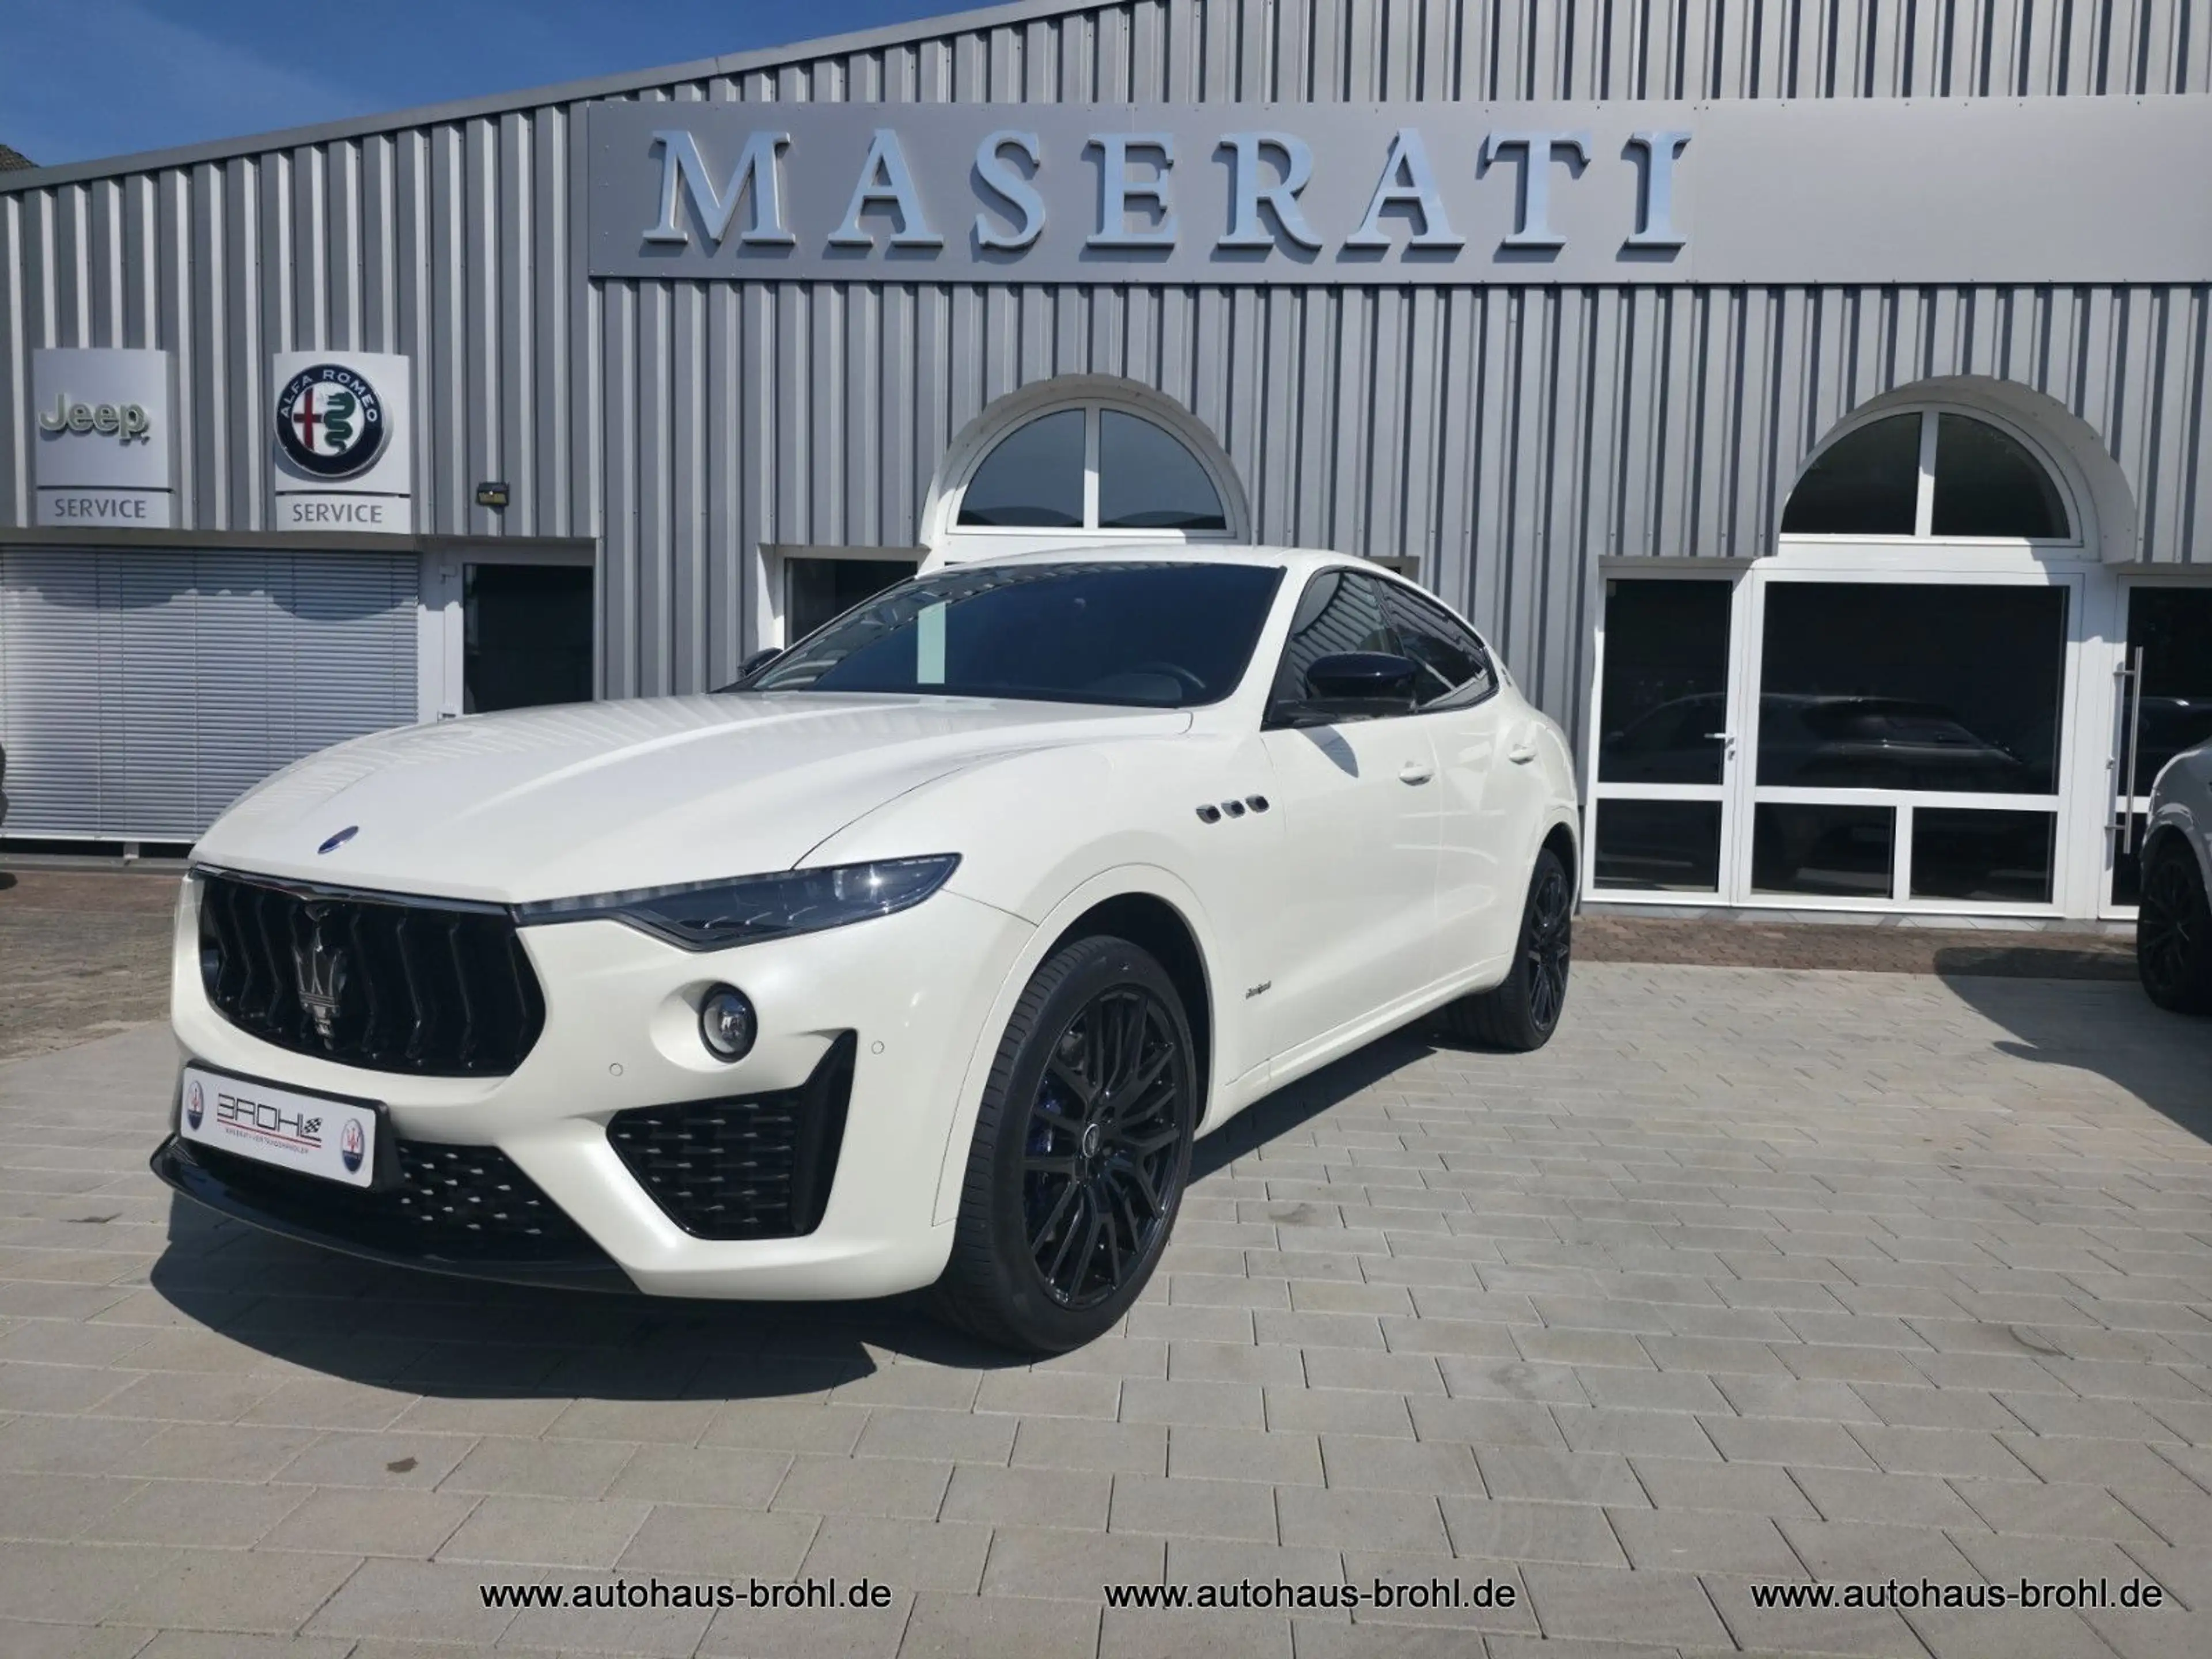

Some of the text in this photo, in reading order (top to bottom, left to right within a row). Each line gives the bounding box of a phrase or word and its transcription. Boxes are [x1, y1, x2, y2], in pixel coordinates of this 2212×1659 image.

[643, 127, 1692, 250] MASERATI
[39, 393, 147, 440] Jeep
[281, 369, 378, 422] ALFA ROMEO
[55, 498, 146, 519] SERVICE
[292, 503, 382, 524] SERVICE
